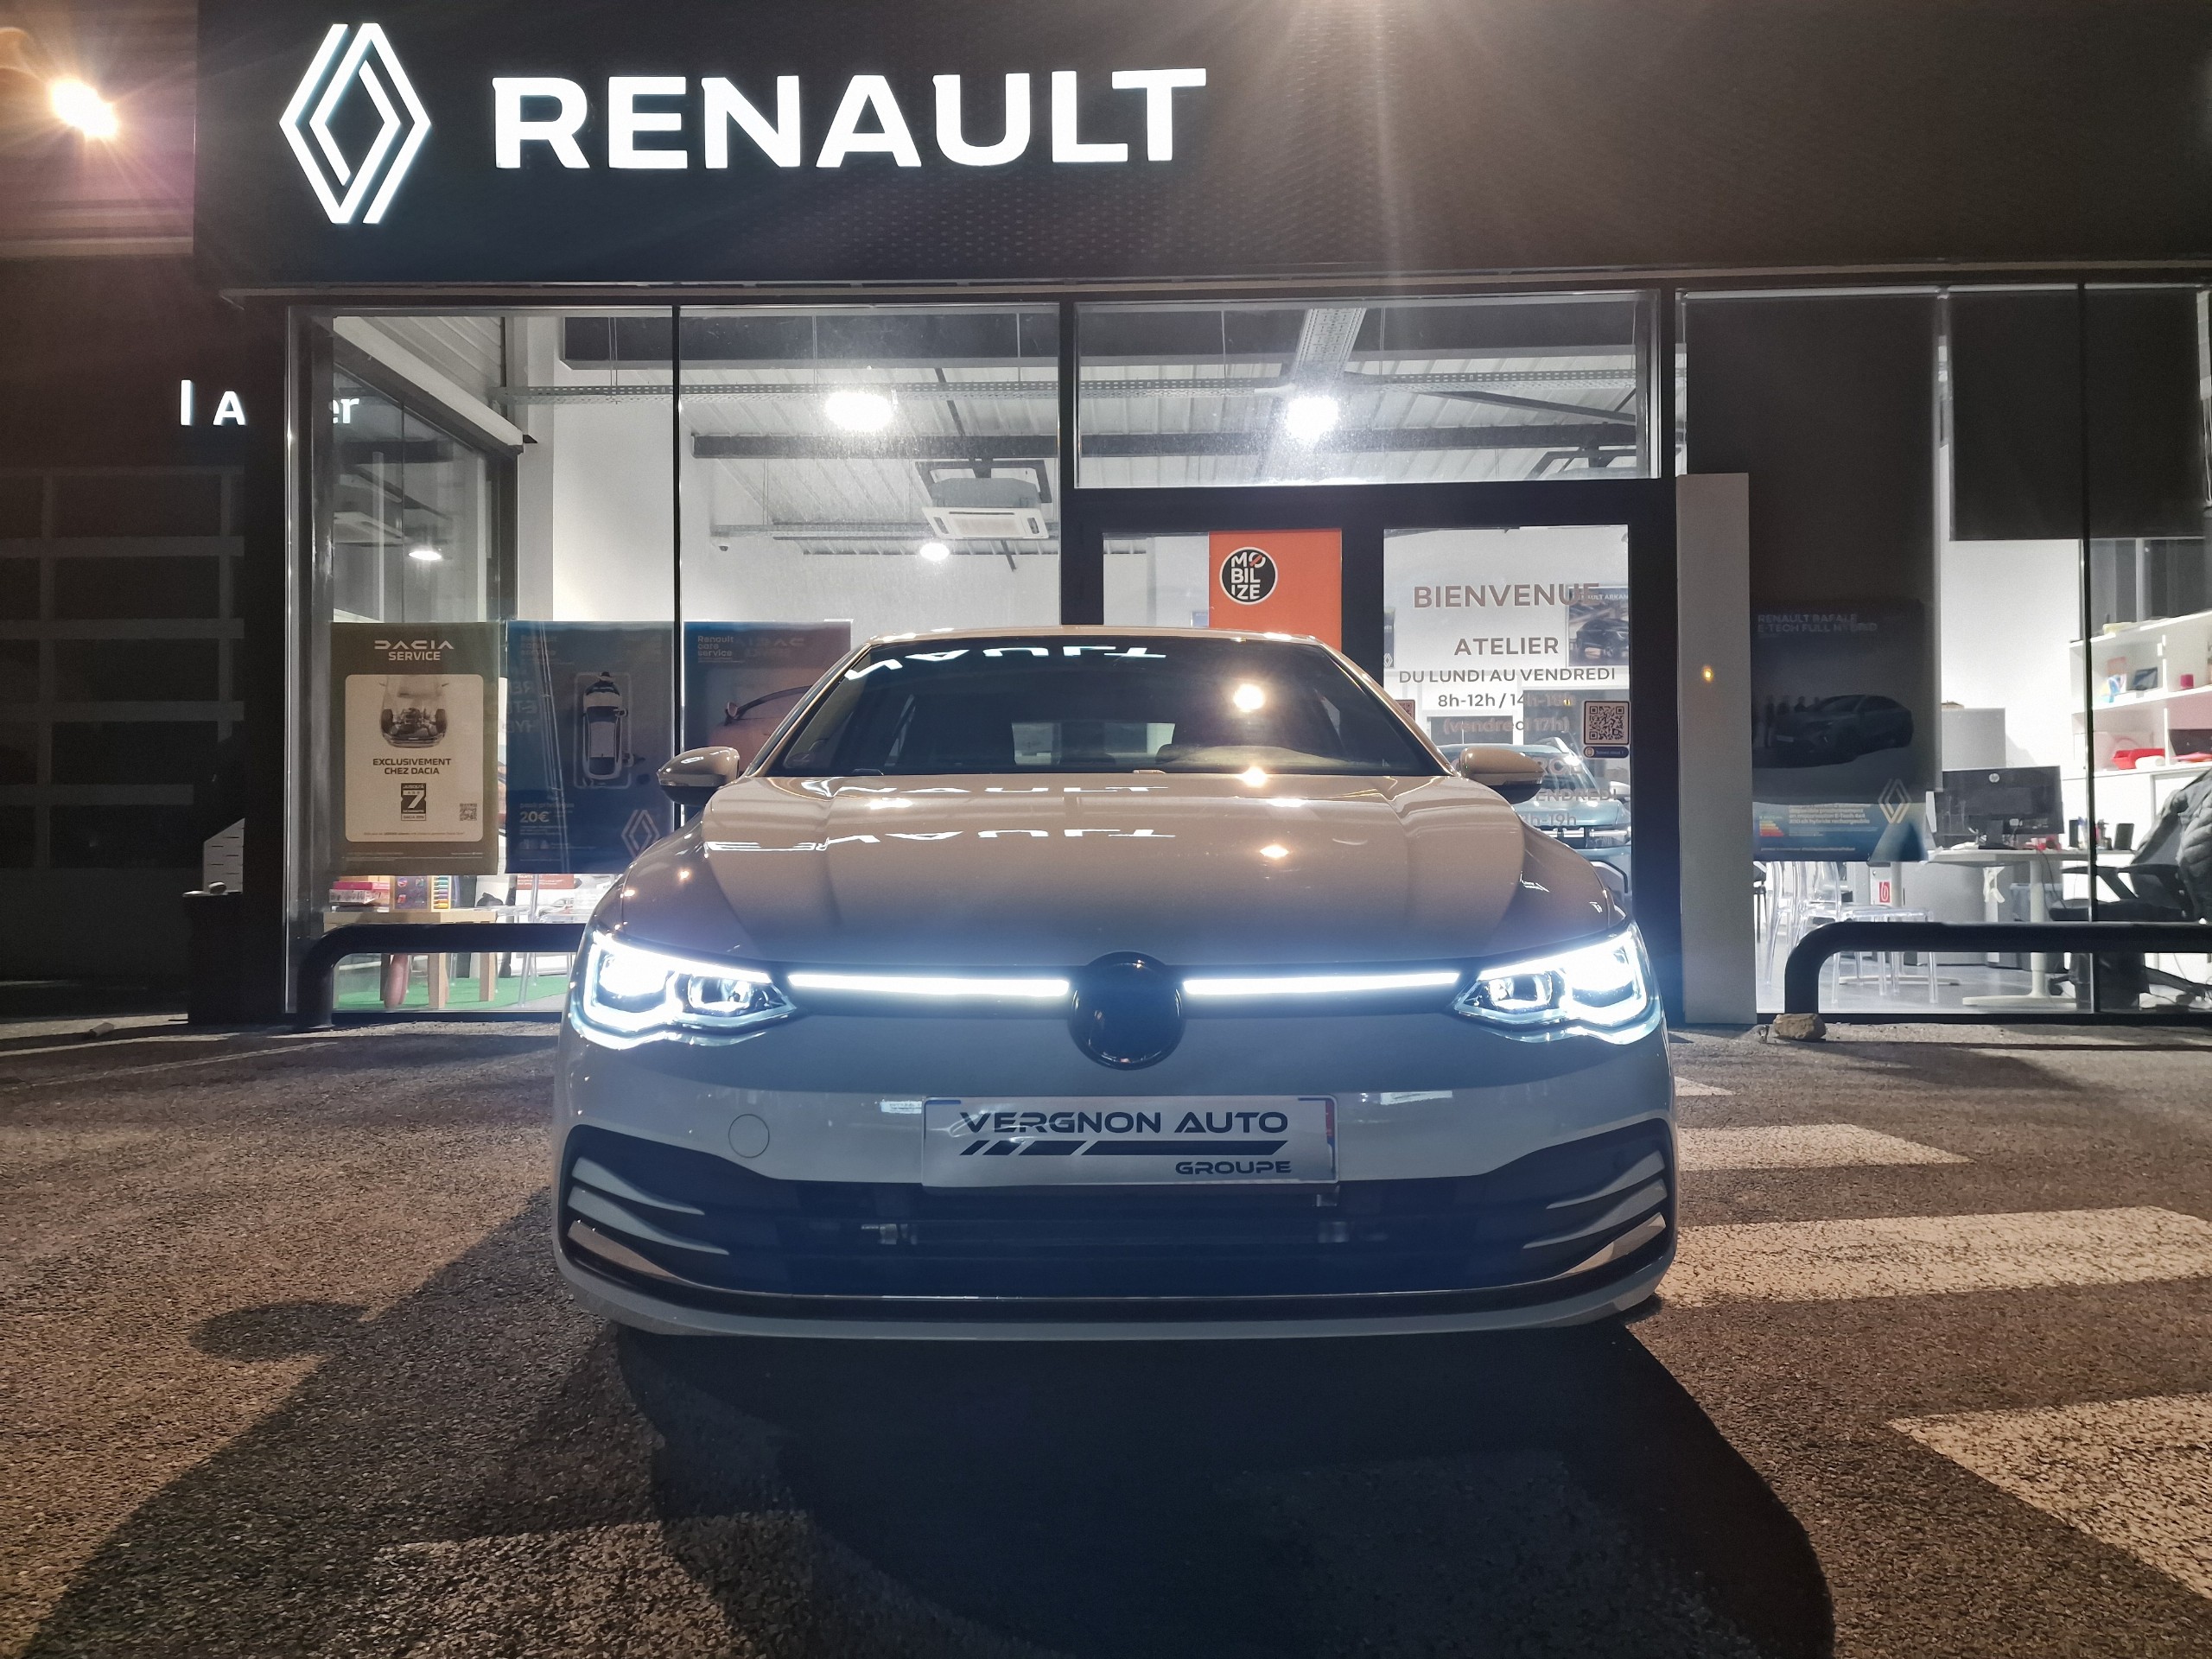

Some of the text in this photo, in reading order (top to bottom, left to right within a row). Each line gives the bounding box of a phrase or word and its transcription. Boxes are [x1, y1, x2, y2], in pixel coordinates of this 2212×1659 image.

[492, 67, 1208, 170] RENAULT
[1414, 582, 1600, 608] BIENVENUE
[1758, 613, 1809, 623] RENAULT
[1758, 623, 1799, 632] E-TECH
[1802, 623, 1831, 632] FULL
[374, 639, 454, 650] DACIA
[1453, 636, 1559, 656] ATELIER
[388, 651, 442, 661] SERVICE
[1399, 667, 1615, 683] DU LUNDI AU VENDREDI
[1438, 693, 1496, 708] 8h-12h
[372, 758, 452, 766] EXCLUSIVEMENT
[403, 790, 424, 809] 7
[1535, 788, 1617, 802] ENDREDI
[519, 810, 550, 823] 20€
[959, 1111, 1288, 1134] VERGNON AUTO
[1174, 1160, 1293, 1175] GROUPE
